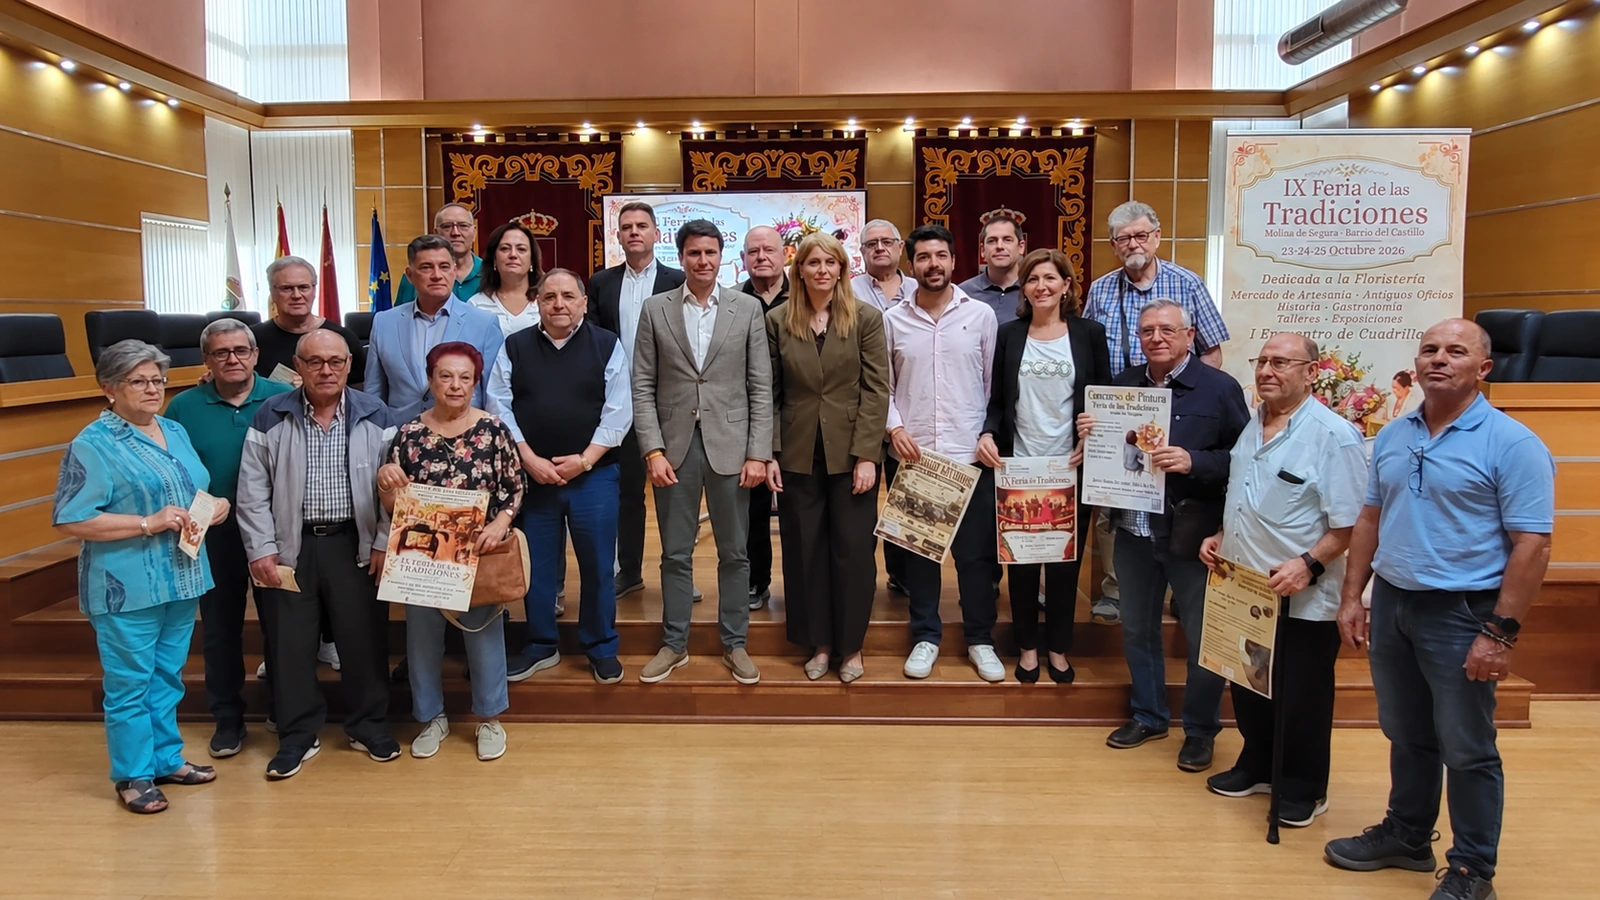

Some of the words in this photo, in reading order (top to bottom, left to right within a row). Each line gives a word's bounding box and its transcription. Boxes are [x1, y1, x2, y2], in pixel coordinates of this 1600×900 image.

[1283, 178, 1307, 197] IX
[1312, 178, 1362, 197] Feria
[1367, 182, 1386, 196] de
[1390, 182, 1410, 196] las
[1263, 199, 1428, 226] Tradiciones
[1265, 229, 1294, 237] Molina
[1296, 229, 1307, 237] de
[1308, 229, 1339, 239] Segura
[1345, 228, 1373, 237] Barrio
[1375, 228, 1389, 236] del
[1391, 228, 1425, 236] Castillo
[1281, 246, 1326, 256] 23-24-25
[1329, 245, 1376, 256] Octubre
[1378, 246, 1405, 255] 2026
[1261, 274, 1320, 284] Dedicada
[1325, 276, 1332, 284] a
[1337, 273, 1349, 284] la
[1354, 273, 1425, 284] Floristería
[1230, 290, 1279, 300] Mercado
[1282, 290, 1295, 300] de
[1363, 290, 1413, 301] Antiguos
[1417, 290, 1454, 301] Oficios
[1277, 302, 1320, 311] Historia
[1332, 302, 1402, 311] Gastronomía
[1277, 314, 1320, 323] Talleres
[1332, 314, 1403, 325] Exposiciones
[1249, 328, 1256, 339] I
[1337, 328, 1354, 339] de
[1125, 392, 1135, 402] de
[1138, 392, 1167, 403] Pintura
